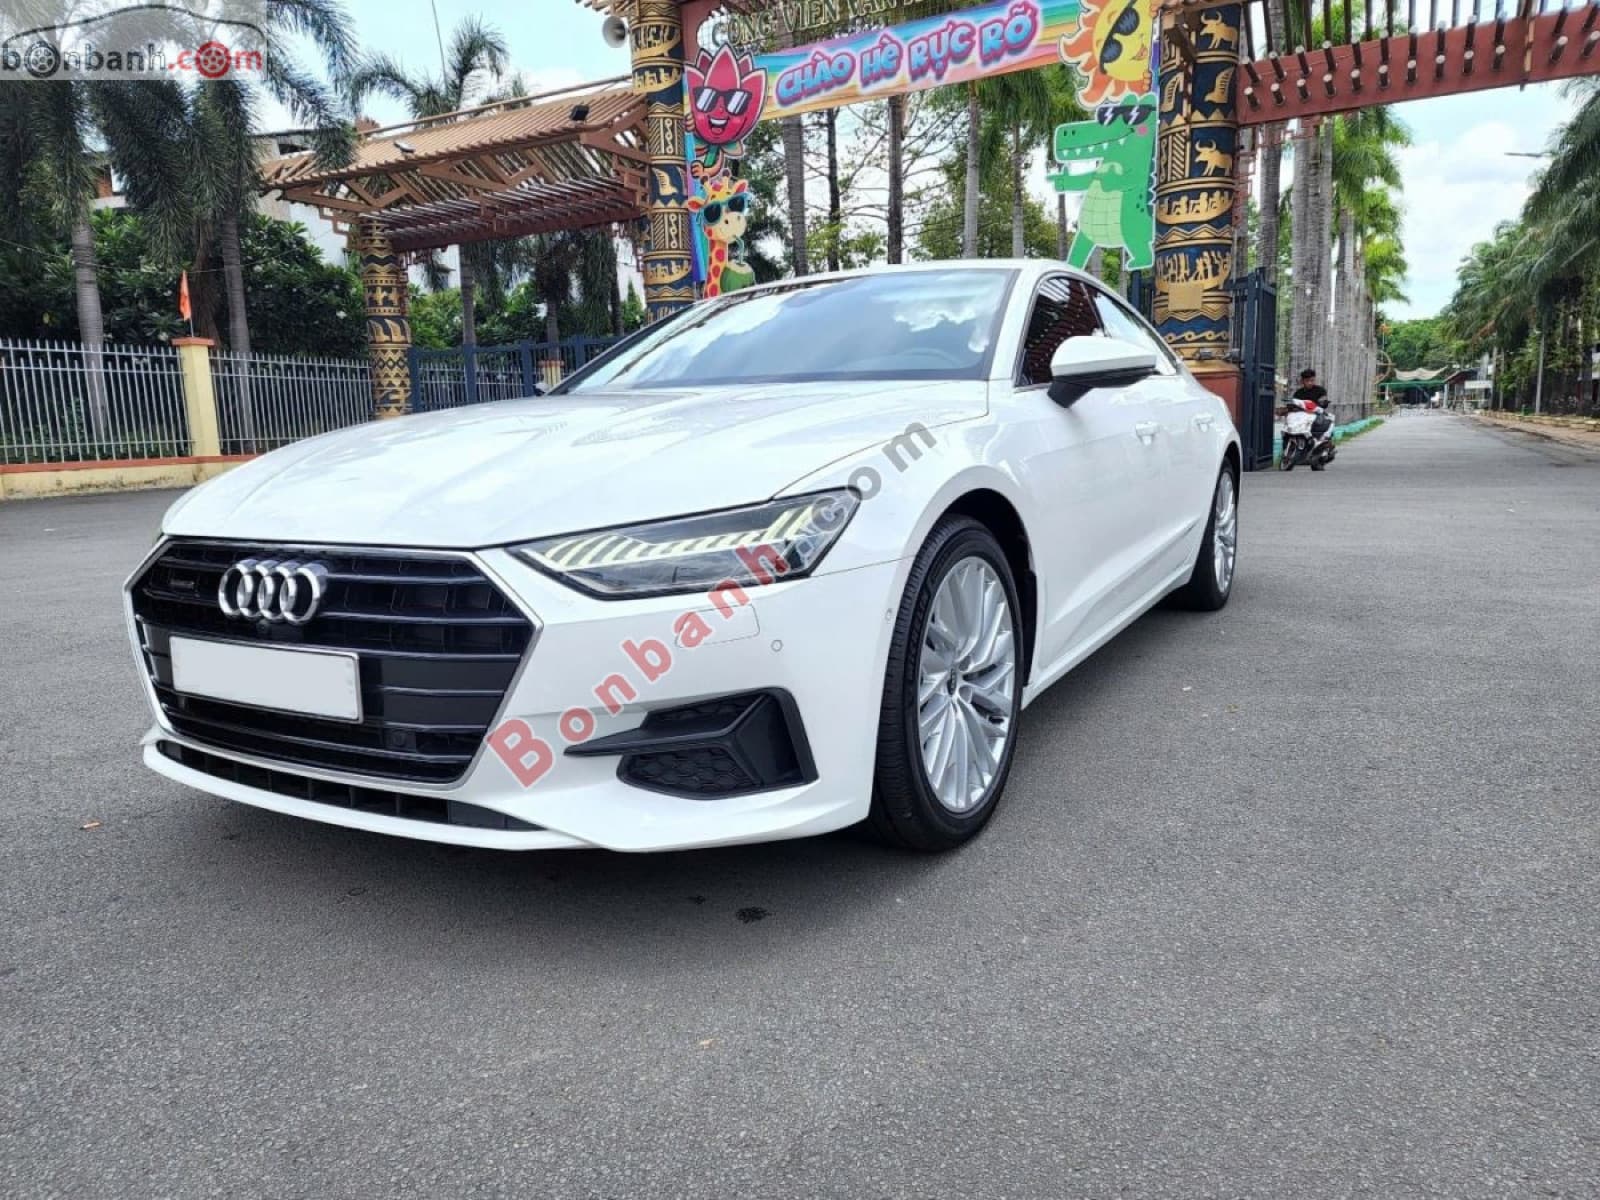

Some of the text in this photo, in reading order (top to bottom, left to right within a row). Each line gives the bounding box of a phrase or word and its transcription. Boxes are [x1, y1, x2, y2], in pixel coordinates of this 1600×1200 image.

[777, 50, 856, 105] CHÀO
[908, 20, 976, 80] RỰC
[979, 2, 1039, 66] RỖ
